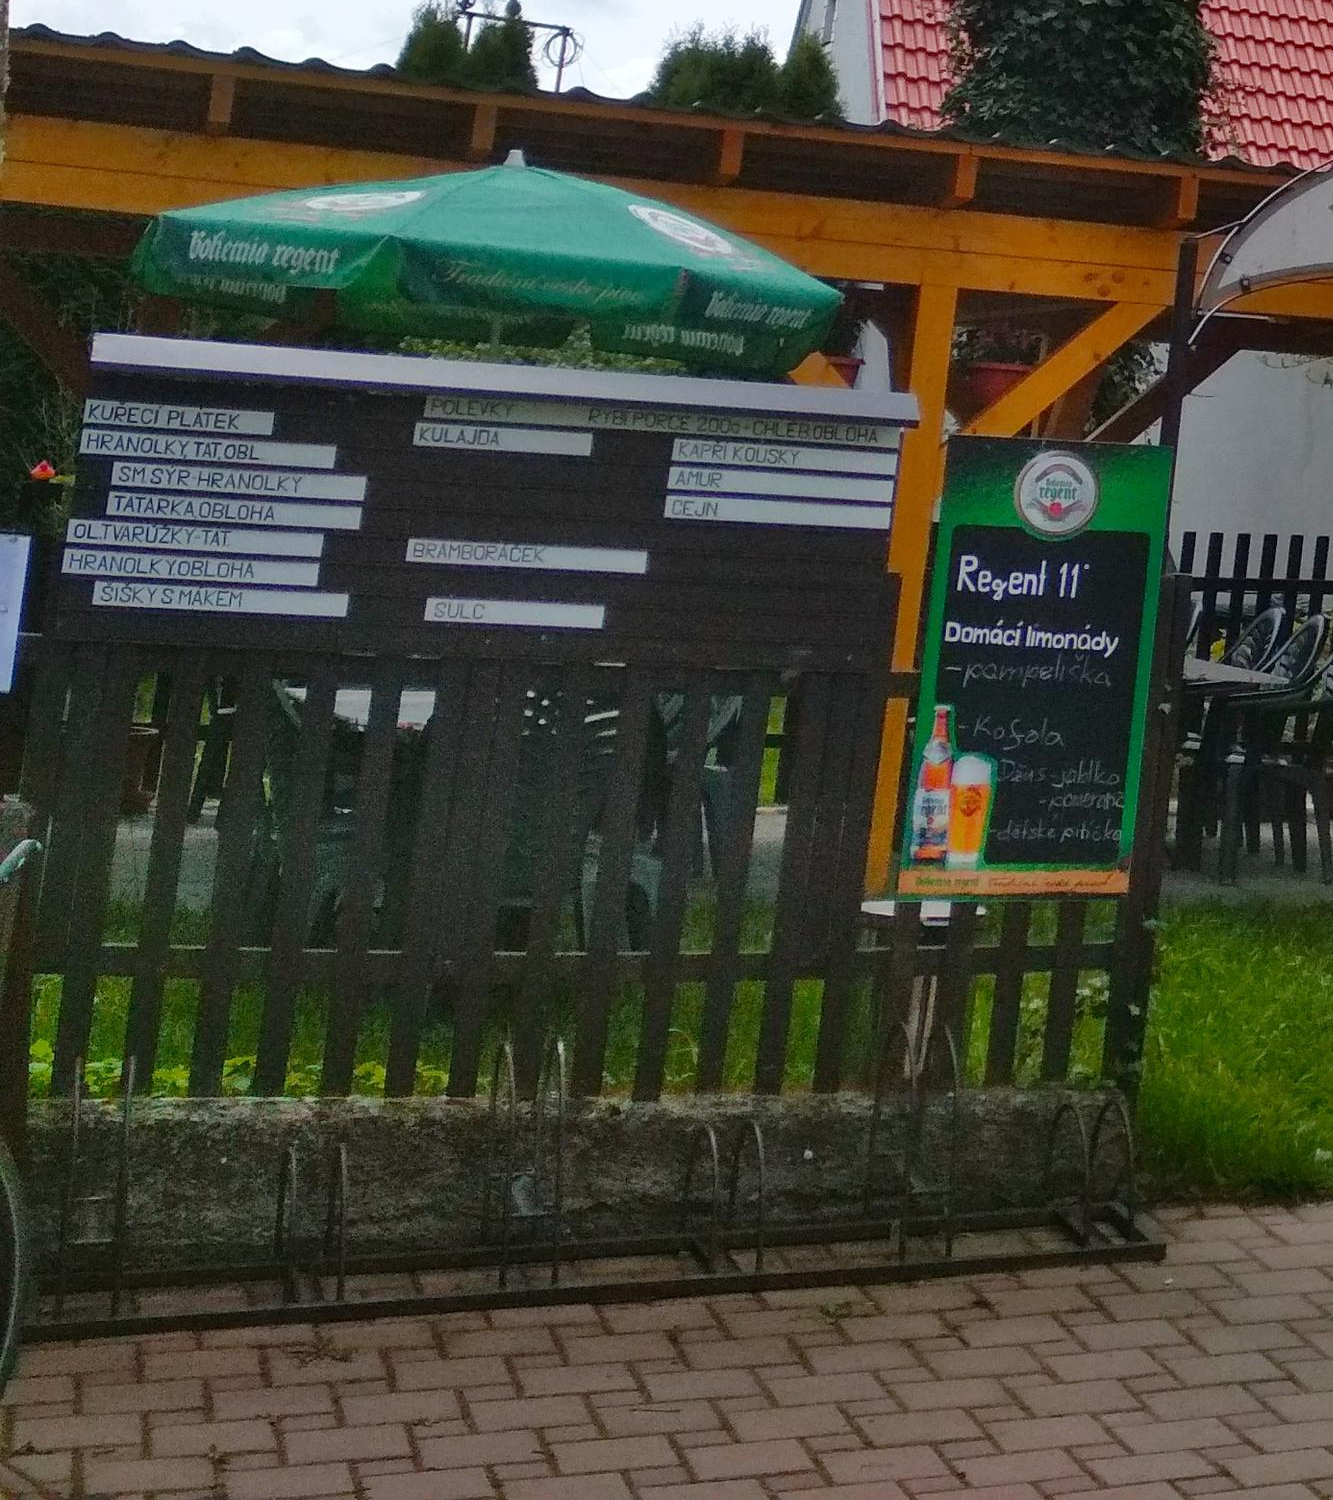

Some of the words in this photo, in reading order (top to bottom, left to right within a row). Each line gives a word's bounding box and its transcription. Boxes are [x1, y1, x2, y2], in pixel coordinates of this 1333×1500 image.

[88, 402, 160, 426] KUŘECÍ
[418, 426, 500, 446] KULAJDA
[732, 445, 800, 466] KOUSKY
[675, 470, 722, 488] AMUR
[671, 499, 718, 518] CEJN
[956, 555, 1047, 601] Regent
[101, 581, 157, 605] ŠIŠKY
[161, 587, 175, 605] S
[434, 602, 486, 620] SULC
[944, 619, 1024, 647] Domácí
[1025, 623, 1119, 659] limonády
